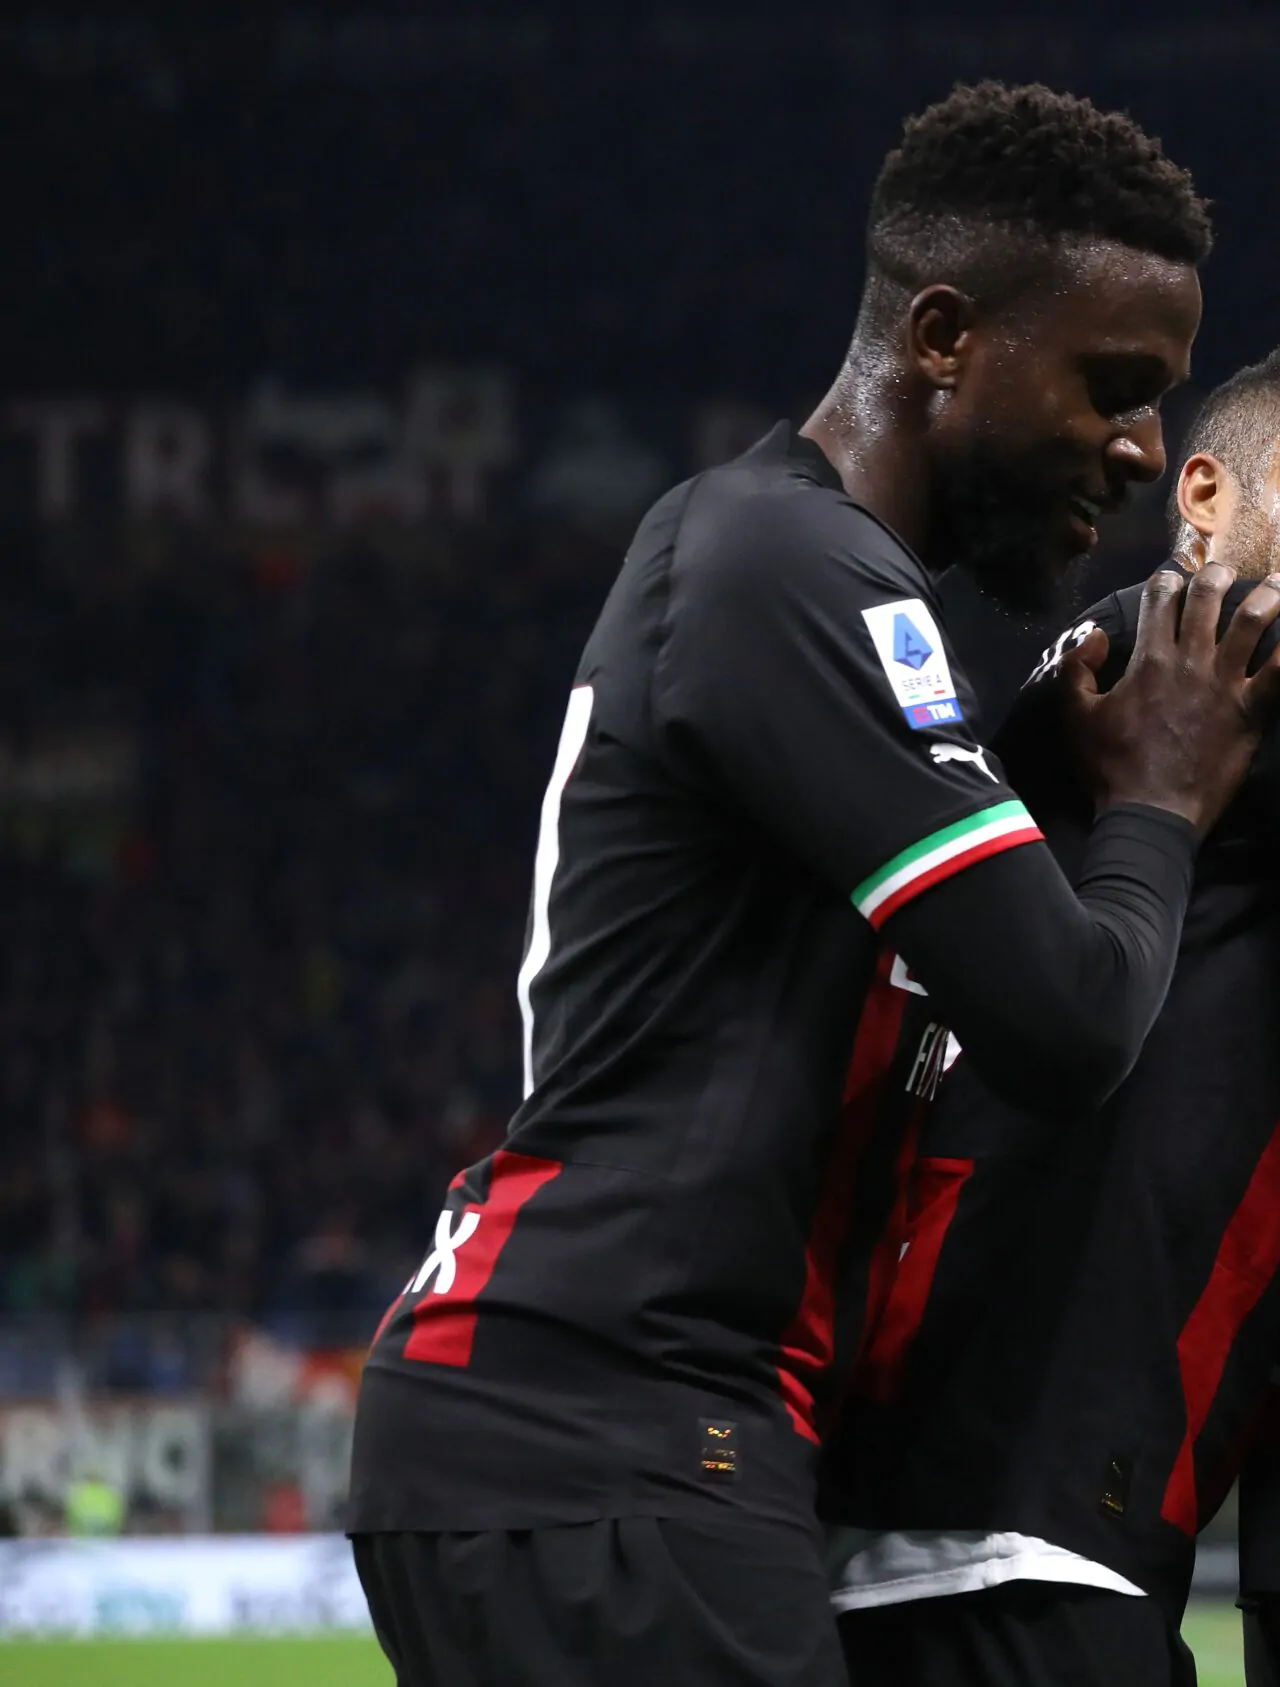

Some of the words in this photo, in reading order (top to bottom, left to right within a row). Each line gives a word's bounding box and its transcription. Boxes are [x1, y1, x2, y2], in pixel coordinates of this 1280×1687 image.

[901, 674, 934, 692] SERIE
[926, 702, 956, 720] TIM
[402, 1209, 481, 1295] X
